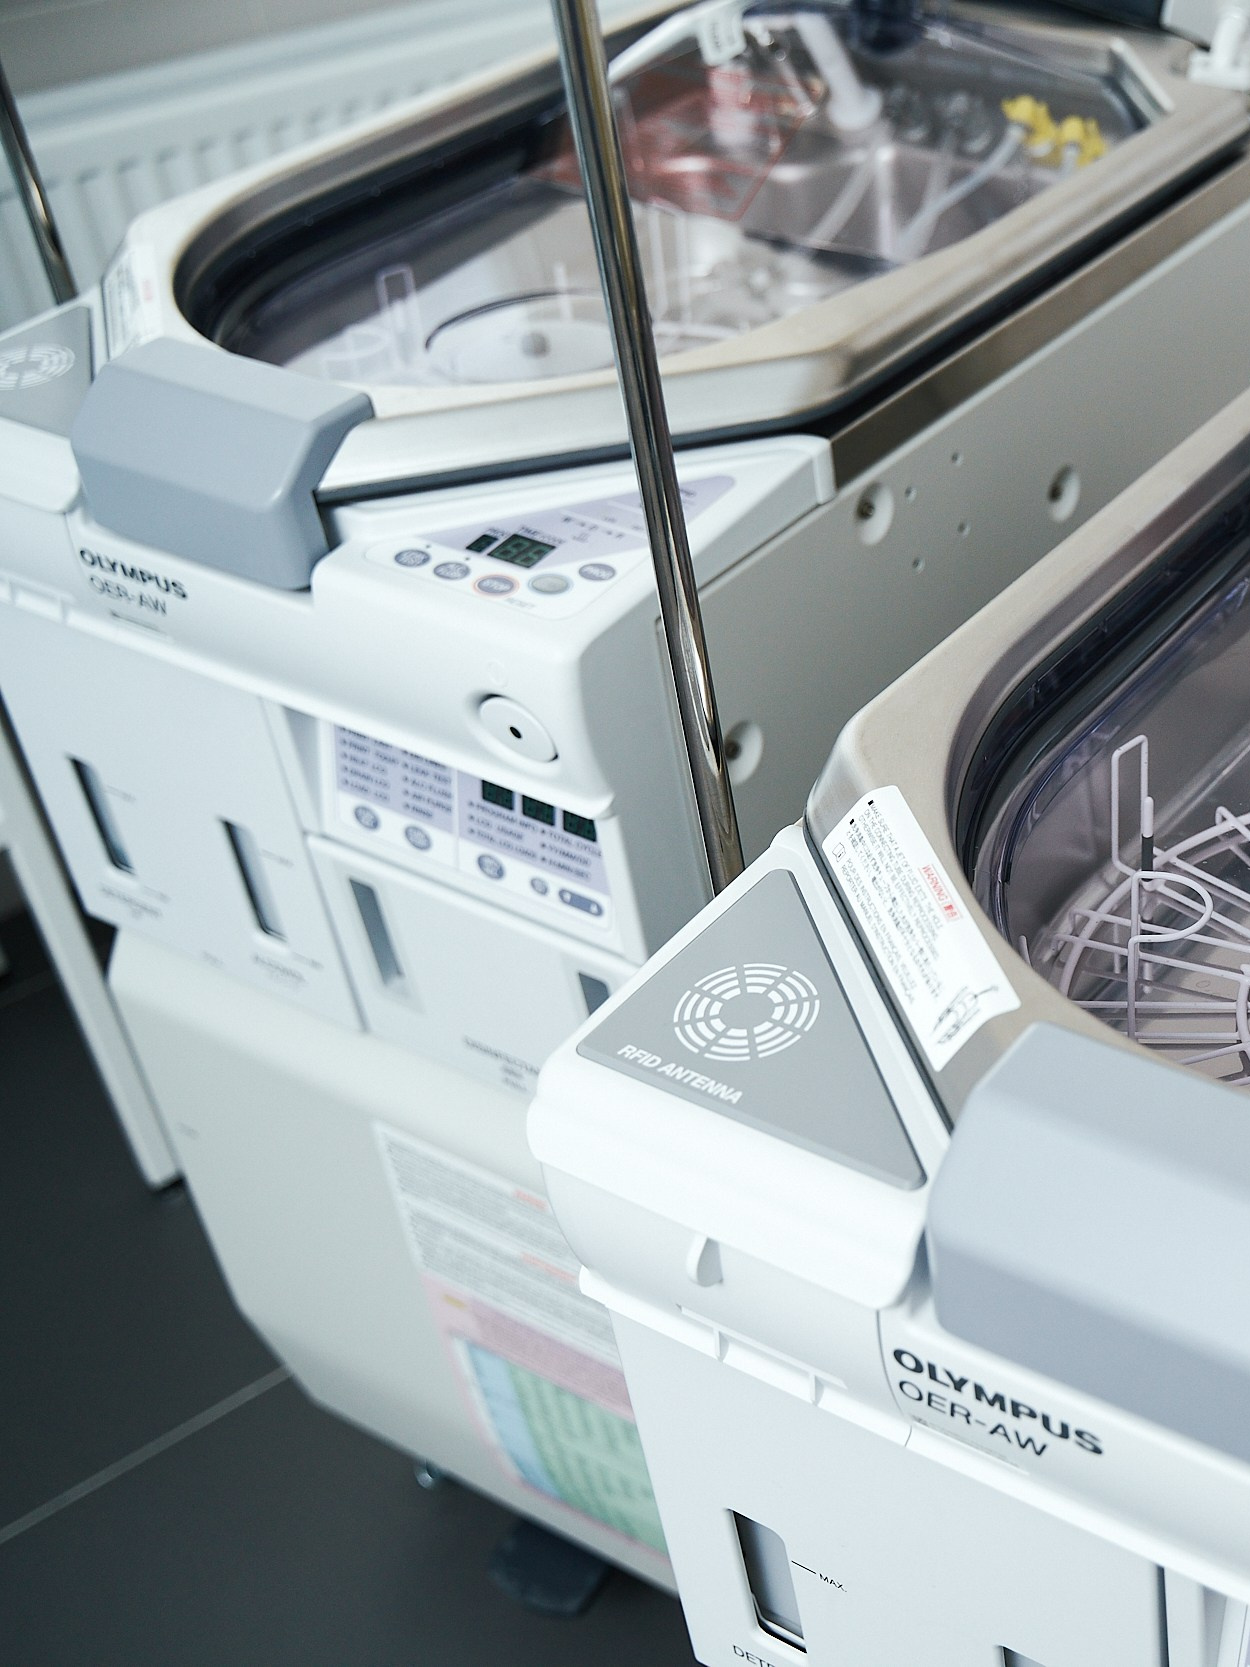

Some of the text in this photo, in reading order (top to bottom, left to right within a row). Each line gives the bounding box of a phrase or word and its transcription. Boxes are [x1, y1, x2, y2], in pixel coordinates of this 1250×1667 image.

[79, 549, 188, 600] OLYMPUS
[89, 574, 168, 617] OER-AW
[869, 803, 881, 819] MAKE
[876, 817, 889, 834] SURE
[857, 814, 878, 847] OTHERWISE
[882, 861, 894, 876] NOT
[872, 826, 896, 863] CONNECTING
[891, 860, 904, 877] TUBE
[899, 874, 915, 898] DURING
[839, 864, 858, 895] REPORTER
[858, 884, 883, 926] INSTRUCTIONS
[920, 862, 948, 903] WARNING
[616, 1042, 744, 1106] RFID ANTENNA
[892, 1347, 1104, 1456] OLYMPUS
[898, 1380, 1048, 1458] OER-AW
